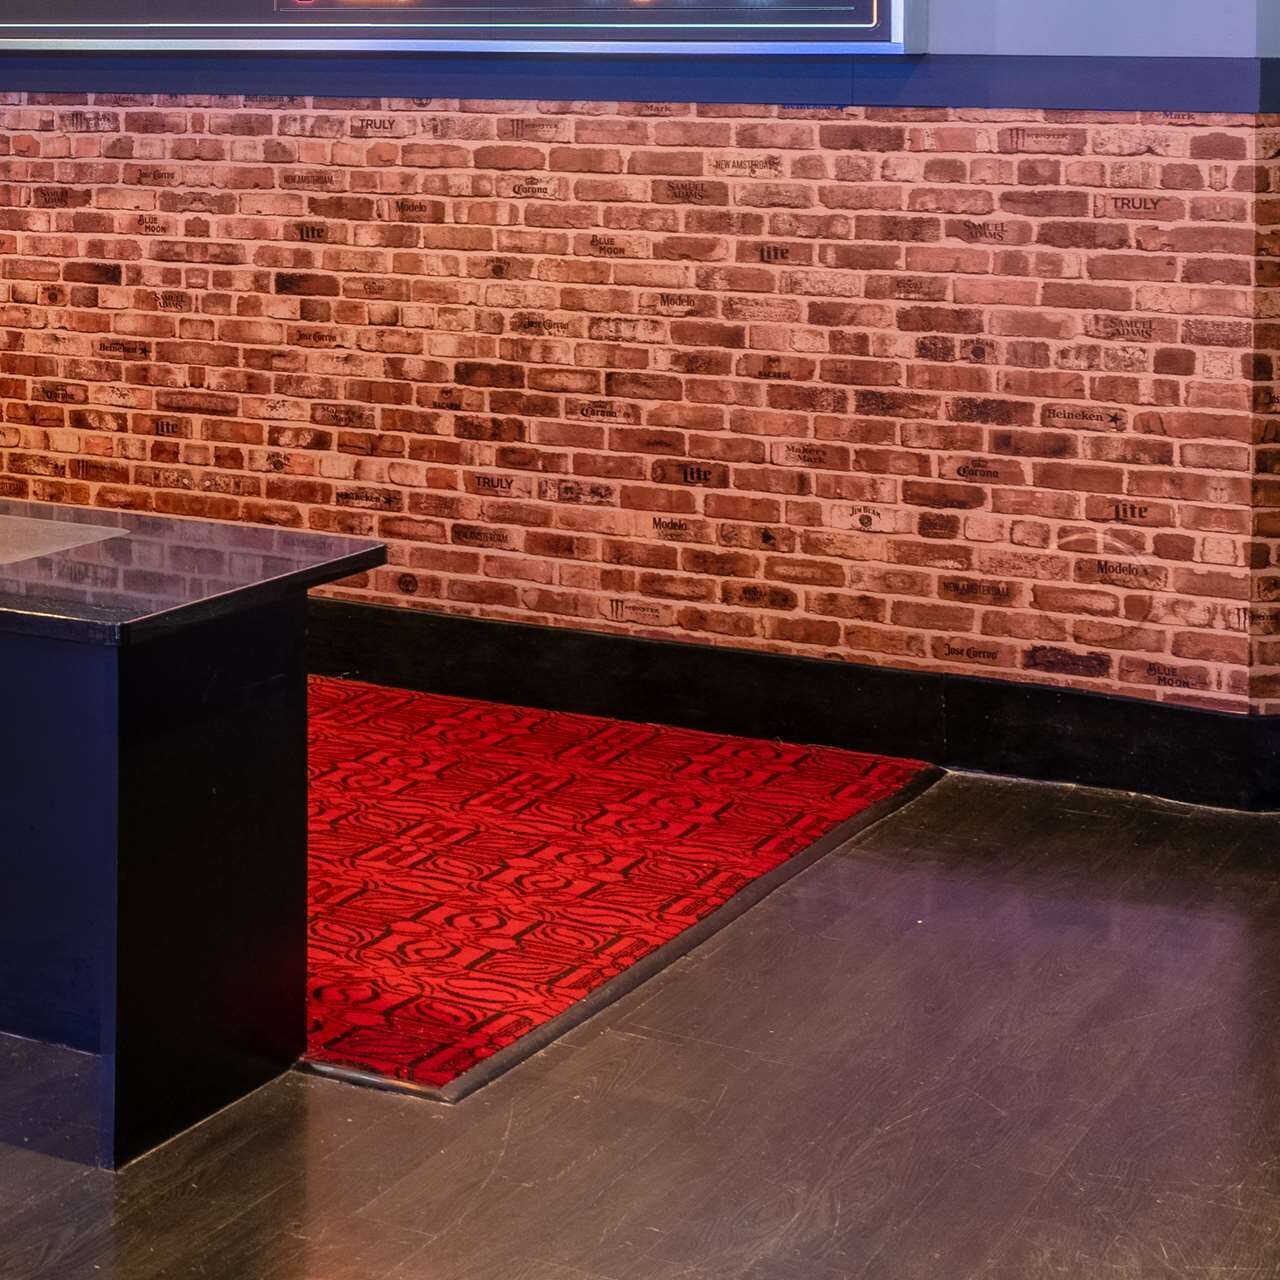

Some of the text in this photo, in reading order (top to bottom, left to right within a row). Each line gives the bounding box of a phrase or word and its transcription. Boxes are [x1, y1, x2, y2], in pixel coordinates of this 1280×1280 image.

[359, 120, 395, 130] TRULY
[513, 183, 547, 195] Corona
[396, 201, 427, 213] Modelo
[1111, 197, 1160, 210] TRULY
[298, 224, 324, 241] Lite
[964, 222, 1008, 232] SAMUEL
[591, 235, 615, 246] BLUE
[967, 230, 1004, 241] ADAMS
[599, 247, 625, 255] MOON
[1048, 408, 1104, 422] Heineken
[682, 464, 711, 483] Lite
[957, 466, 999, 478] Corona
[475, 476, 514, 489] TRULY
[1114, 503, 1148, 520] Lite
[653, 517, 687, 530] Modelo
[1097, 560, 1138, 576] Modelo
[944, 644, 998, 660] Jose Cuervo
